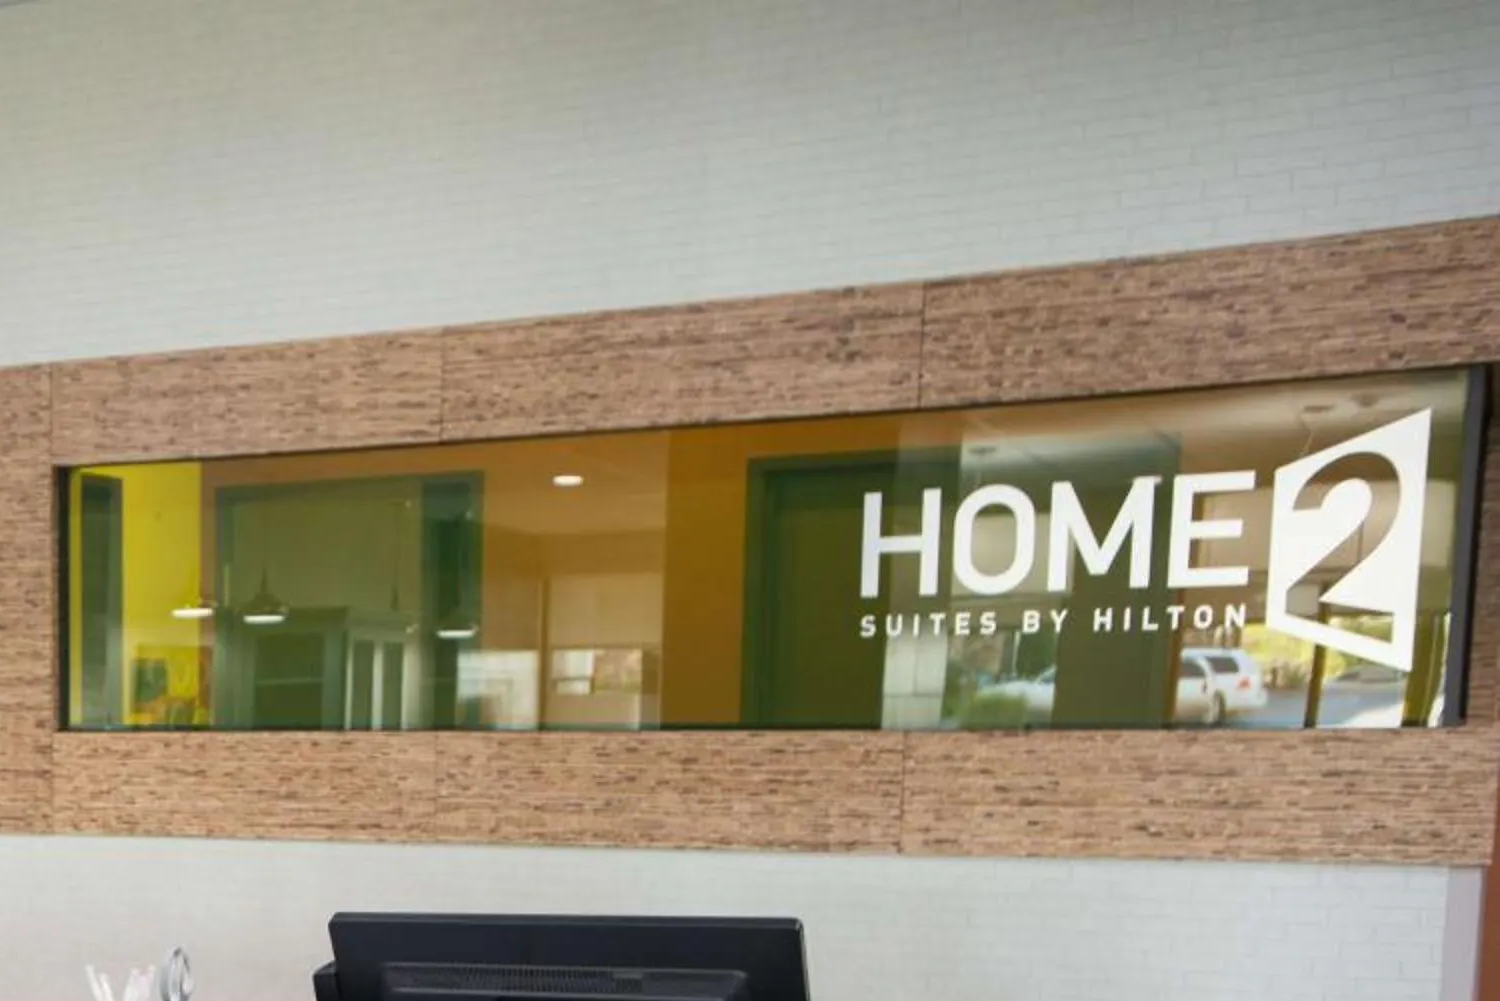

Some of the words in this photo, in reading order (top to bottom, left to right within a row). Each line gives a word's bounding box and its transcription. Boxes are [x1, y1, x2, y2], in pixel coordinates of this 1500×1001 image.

[859, 612, 998, 638] SUITES
[1022, 609, 1069, 634] BY
[1093, 603, 1248, 633] HILTON
